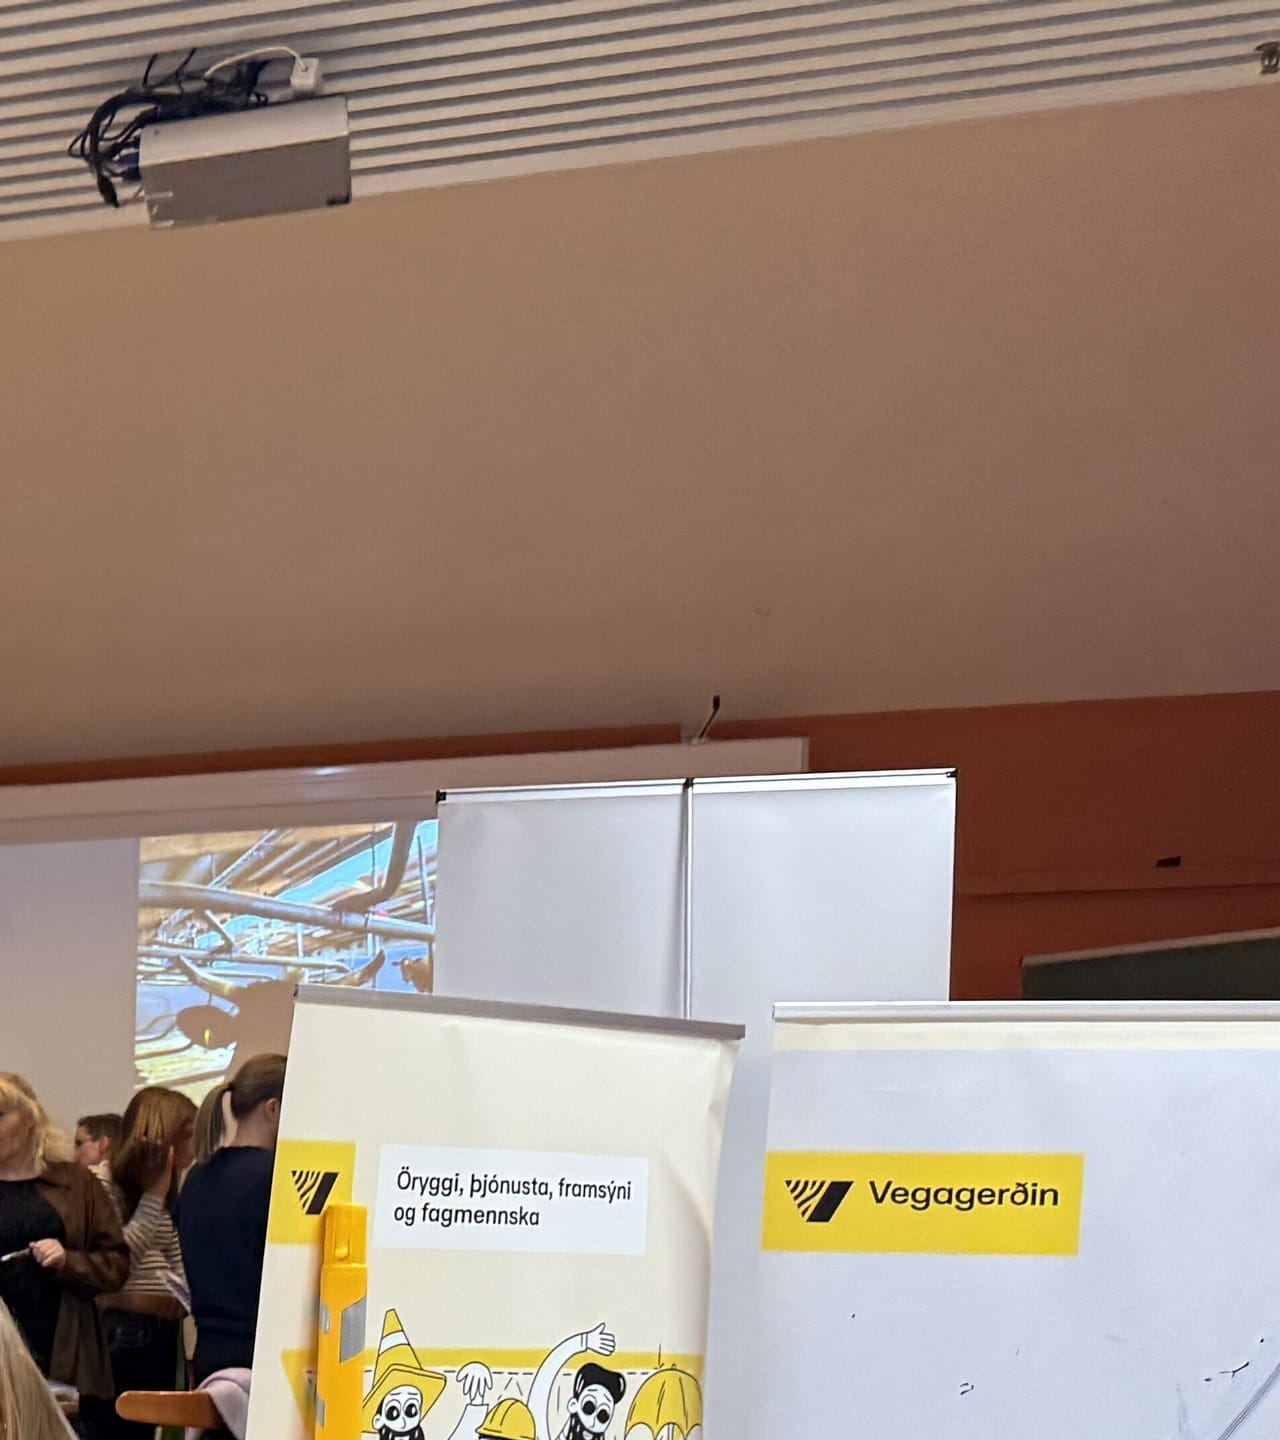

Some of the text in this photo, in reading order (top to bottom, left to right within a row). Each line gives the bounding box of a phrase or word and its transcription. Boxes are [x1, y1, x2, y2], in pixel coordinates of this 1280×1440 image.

[397, 1166, 631, 1204] Öryggi, þjónusta, framsýni
[869, 1180, 1059, 1211] Vegagerðin
[394, 1202, 540, 1228] og fagmennska
